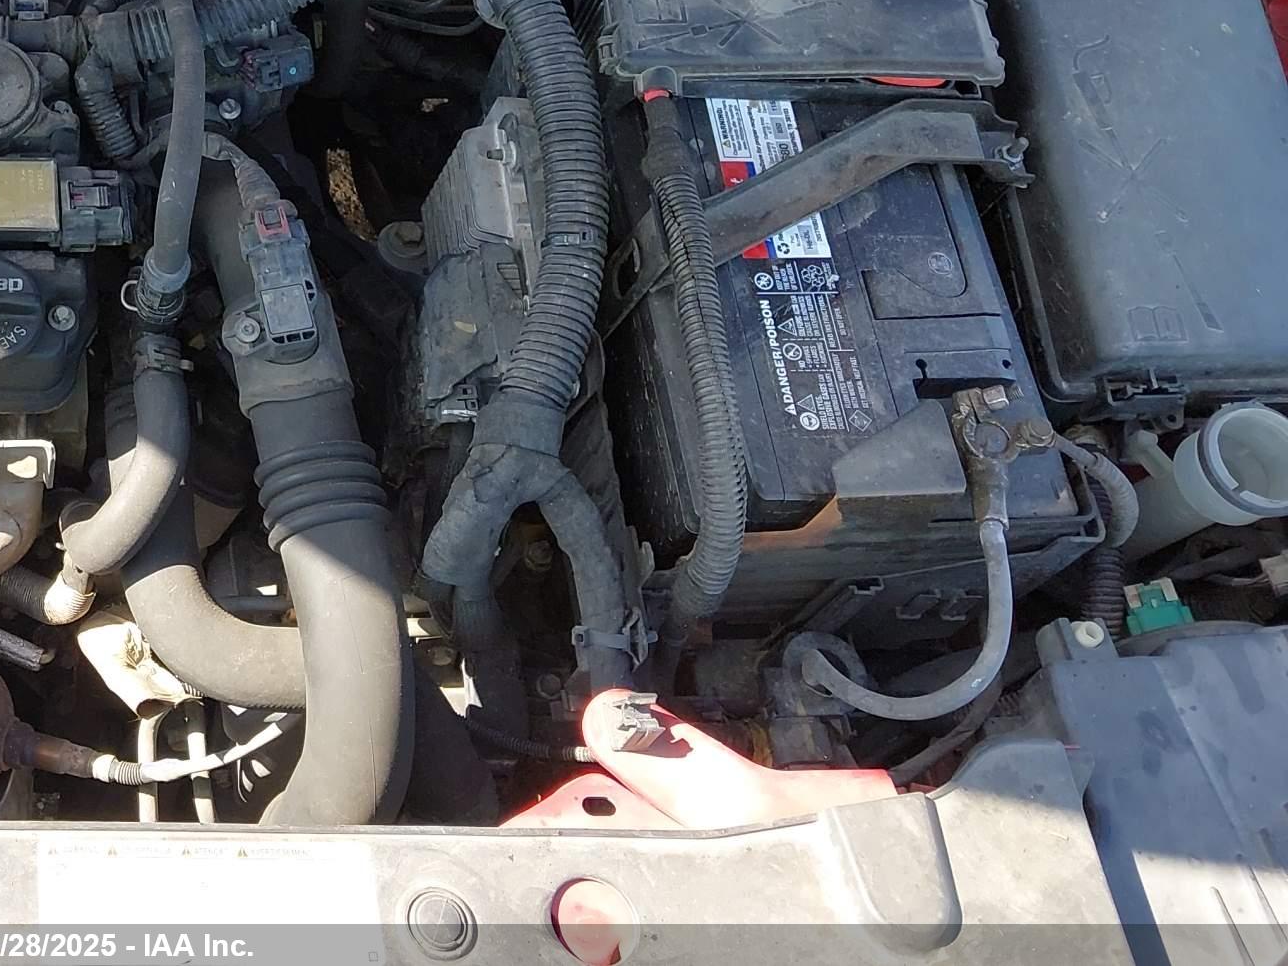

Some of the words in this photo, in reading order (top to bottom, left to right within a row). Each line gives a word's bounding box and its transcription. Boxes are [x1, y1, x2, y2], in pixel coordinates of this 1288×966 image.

[715, 107, 729, 139] WARNING:
[826, 333, 836, 347] READ
[760, 300, 793, 402] DANGER/POISON
[852, 368, 861, 379] HELP
[819, 383, 829, 399] GASES
[818, 410, 829, 429] SHIELD
[824, 401, 836, 429] EXPLOSIVE
